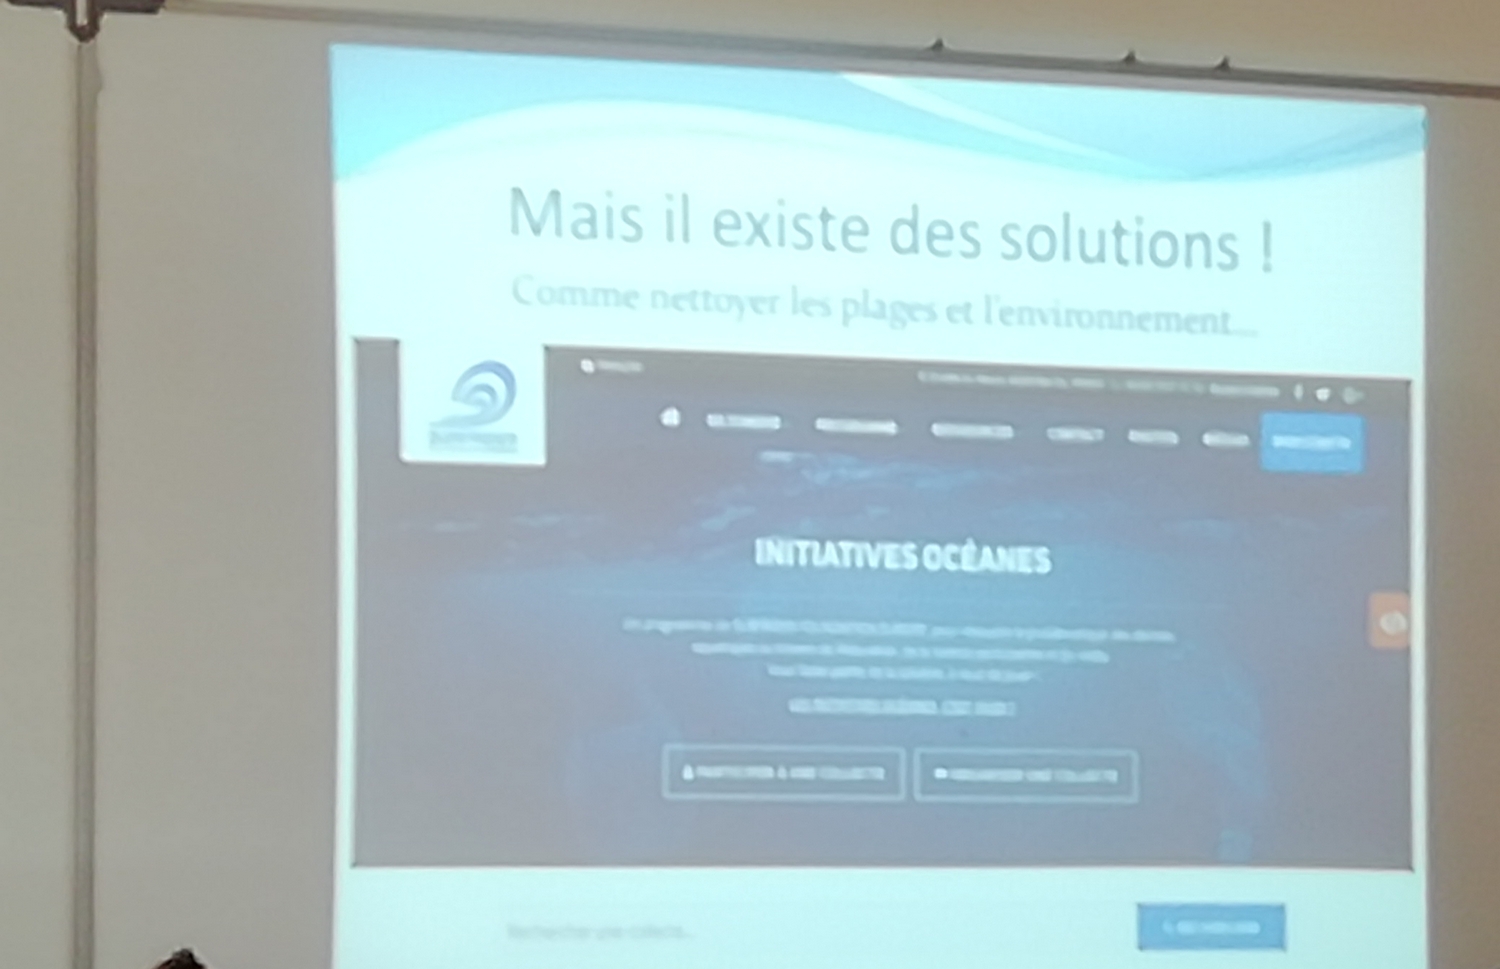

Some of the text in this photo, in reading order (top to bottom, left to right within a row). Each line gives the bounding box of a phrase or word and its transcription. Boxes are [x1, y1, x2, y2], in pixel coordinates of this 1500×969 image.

[510, 186, 1274, 274] Mais il existe des solutions !
[512, 274, 640, 312] Comme
[650, 284, 779, 323] nettoyer
[790, 284, 832, 319] les
[841, 287, 937, 330] plages
[945, 293, 974, 326] et
[754, 537, 1053, 575] INITIATIVES OCÉANES
